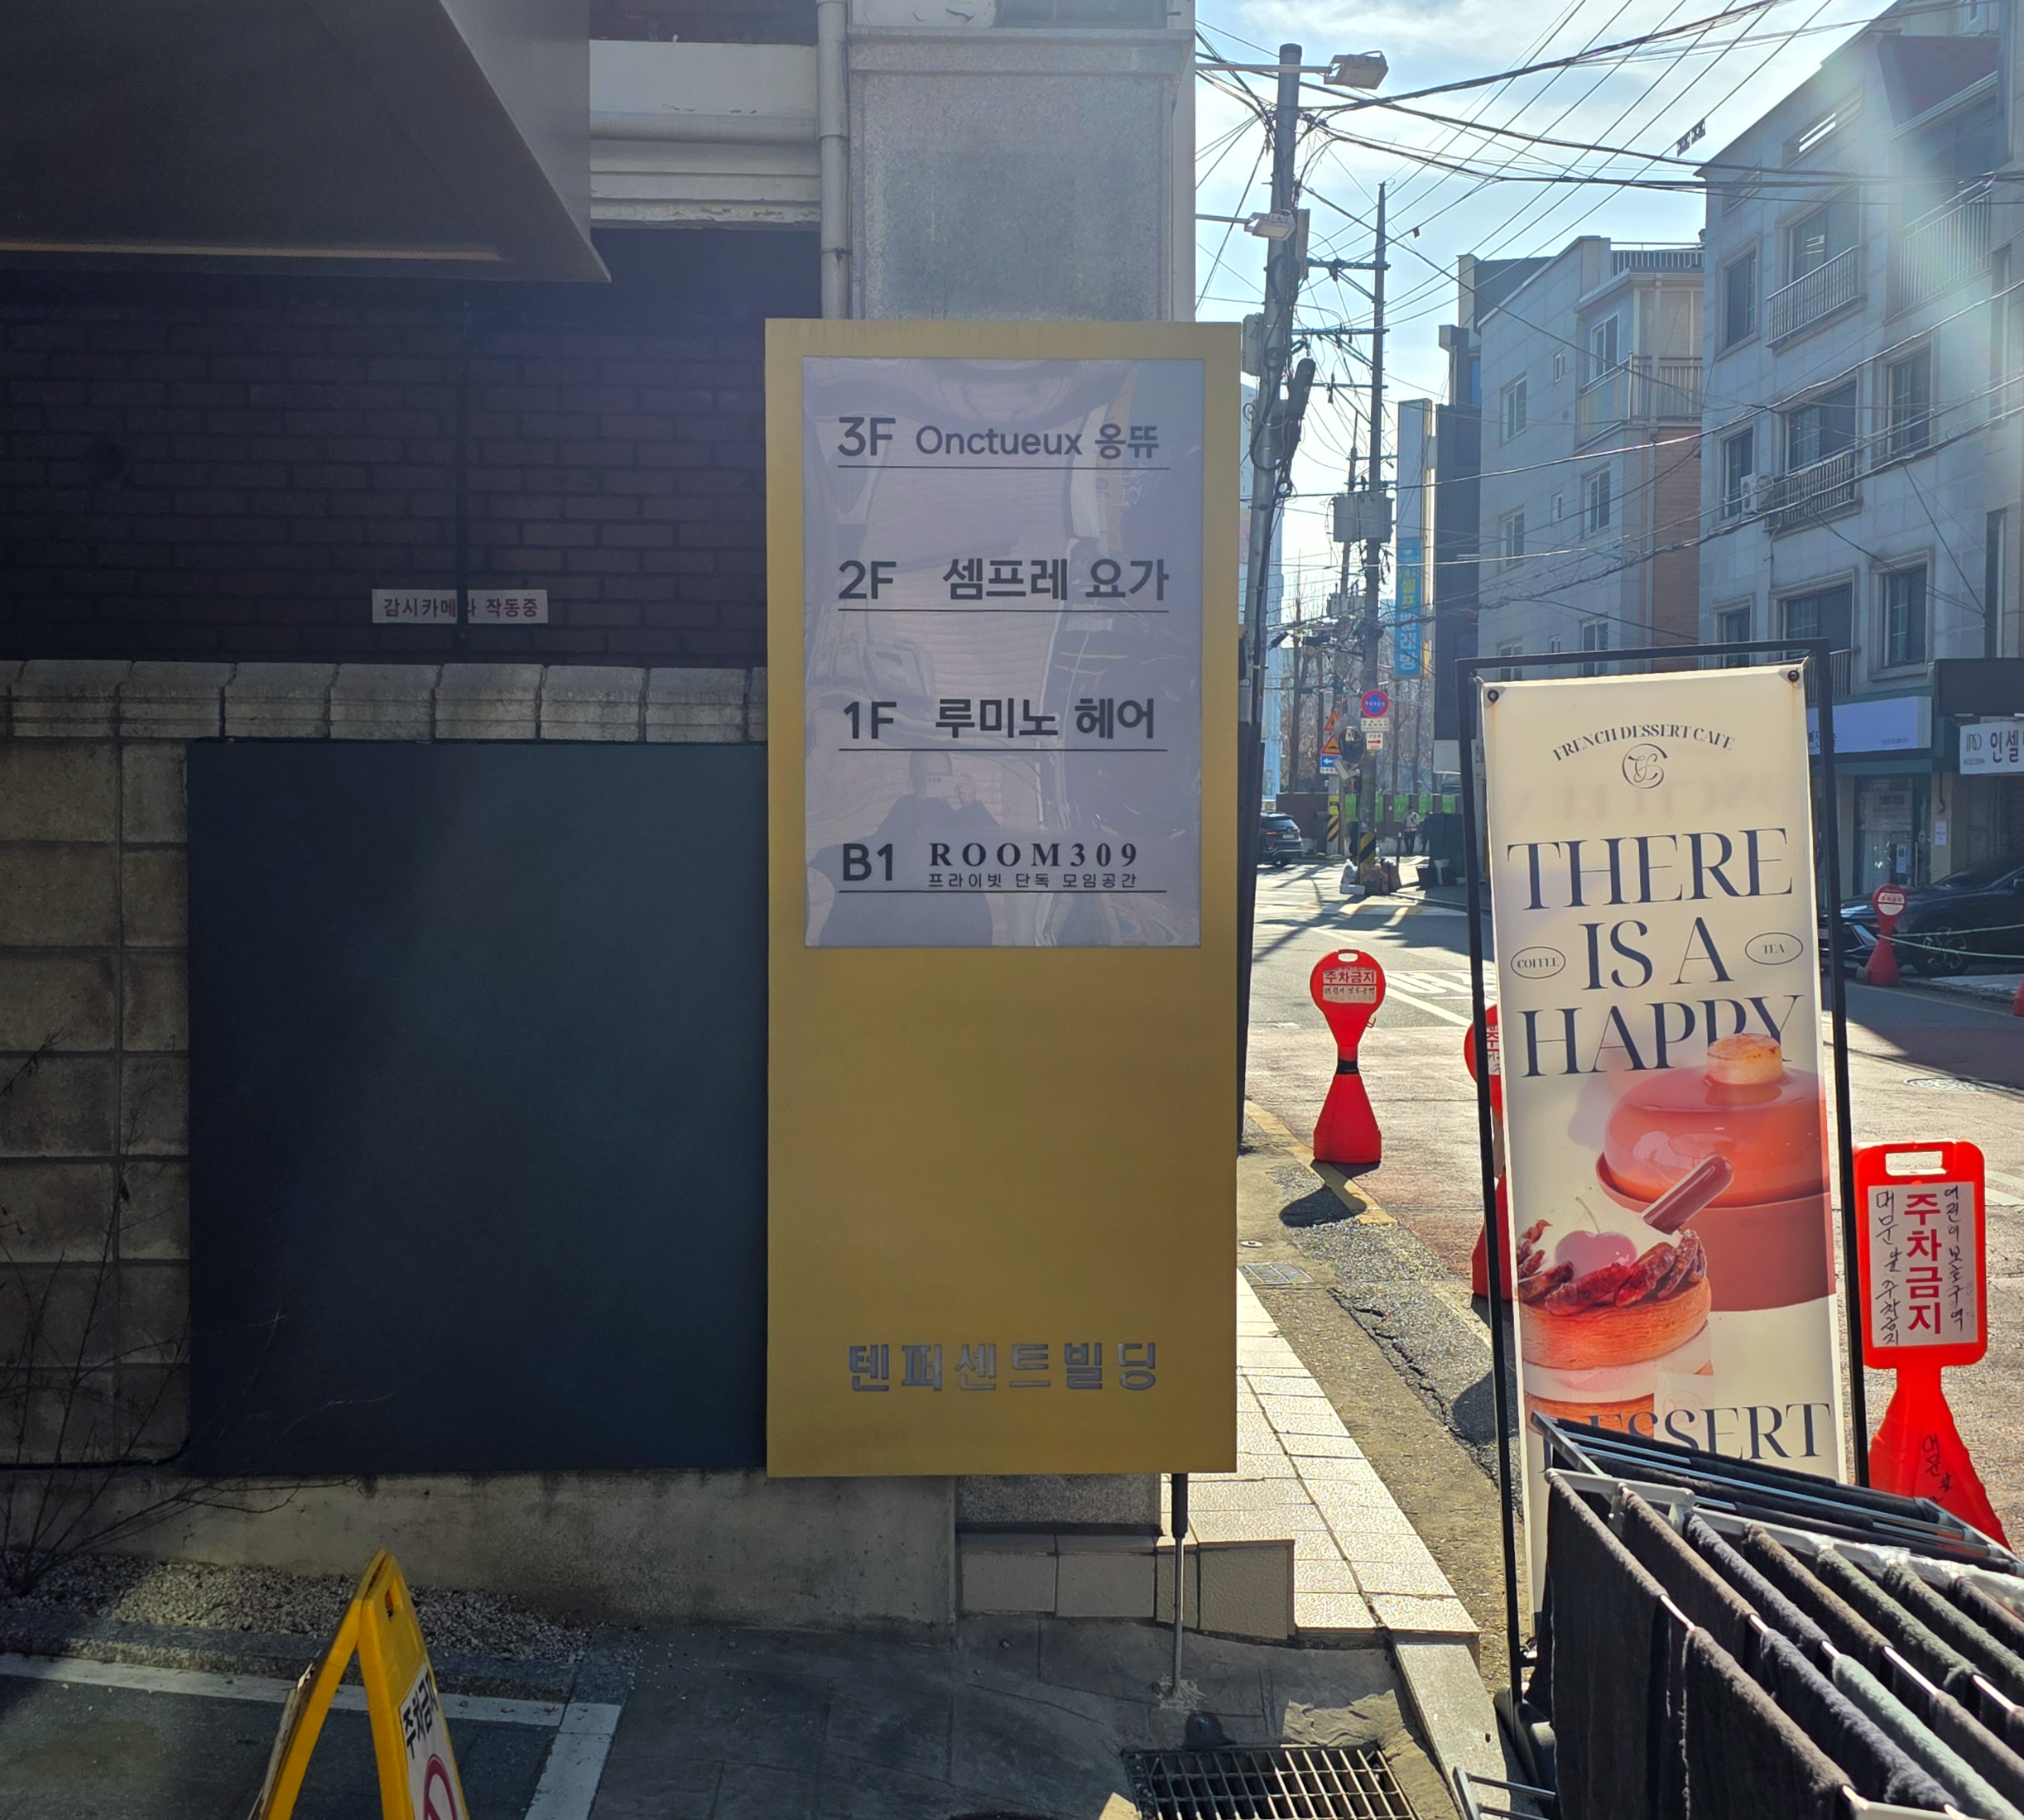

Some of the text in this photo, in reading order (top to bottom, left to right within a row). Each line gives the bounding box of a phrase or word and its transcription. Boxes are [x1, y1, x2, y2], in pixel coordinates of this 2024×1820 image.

[837, 416, 1160, 459] 3F Onctueux 옹뜌
[838, 558, 1171, 601] 2F 셈프레 요가
[485, 598, 539, 618] 작동중
[843, 698, 1155, 739] 1F 루미노 헤어
[1552, 723, 1736, 761] FRENCH DESSERT CAFE
[1990, 731, 2024, 763] 인셀
[841, 842, 1139, 882] B1 ROOM309
[928, 872, 1137, 889] 프라이빗 단독 모임공간
[1507, 828, 1794, 910] THERE
[1578, 917, 1735, 991] IS A
[1762, 943, 1786, 954] TEA
[1324, 970, 1375, 983] 주차금지
[1517, 995, 1805, 1078] HAPPY
[1904, 1193, 1943, 1334] 주차금지
[1944, 1185, 1964, 1332] 어린이 보호구역
[849, 1342, 1157, 1392] 텐퍼센트빌딩
